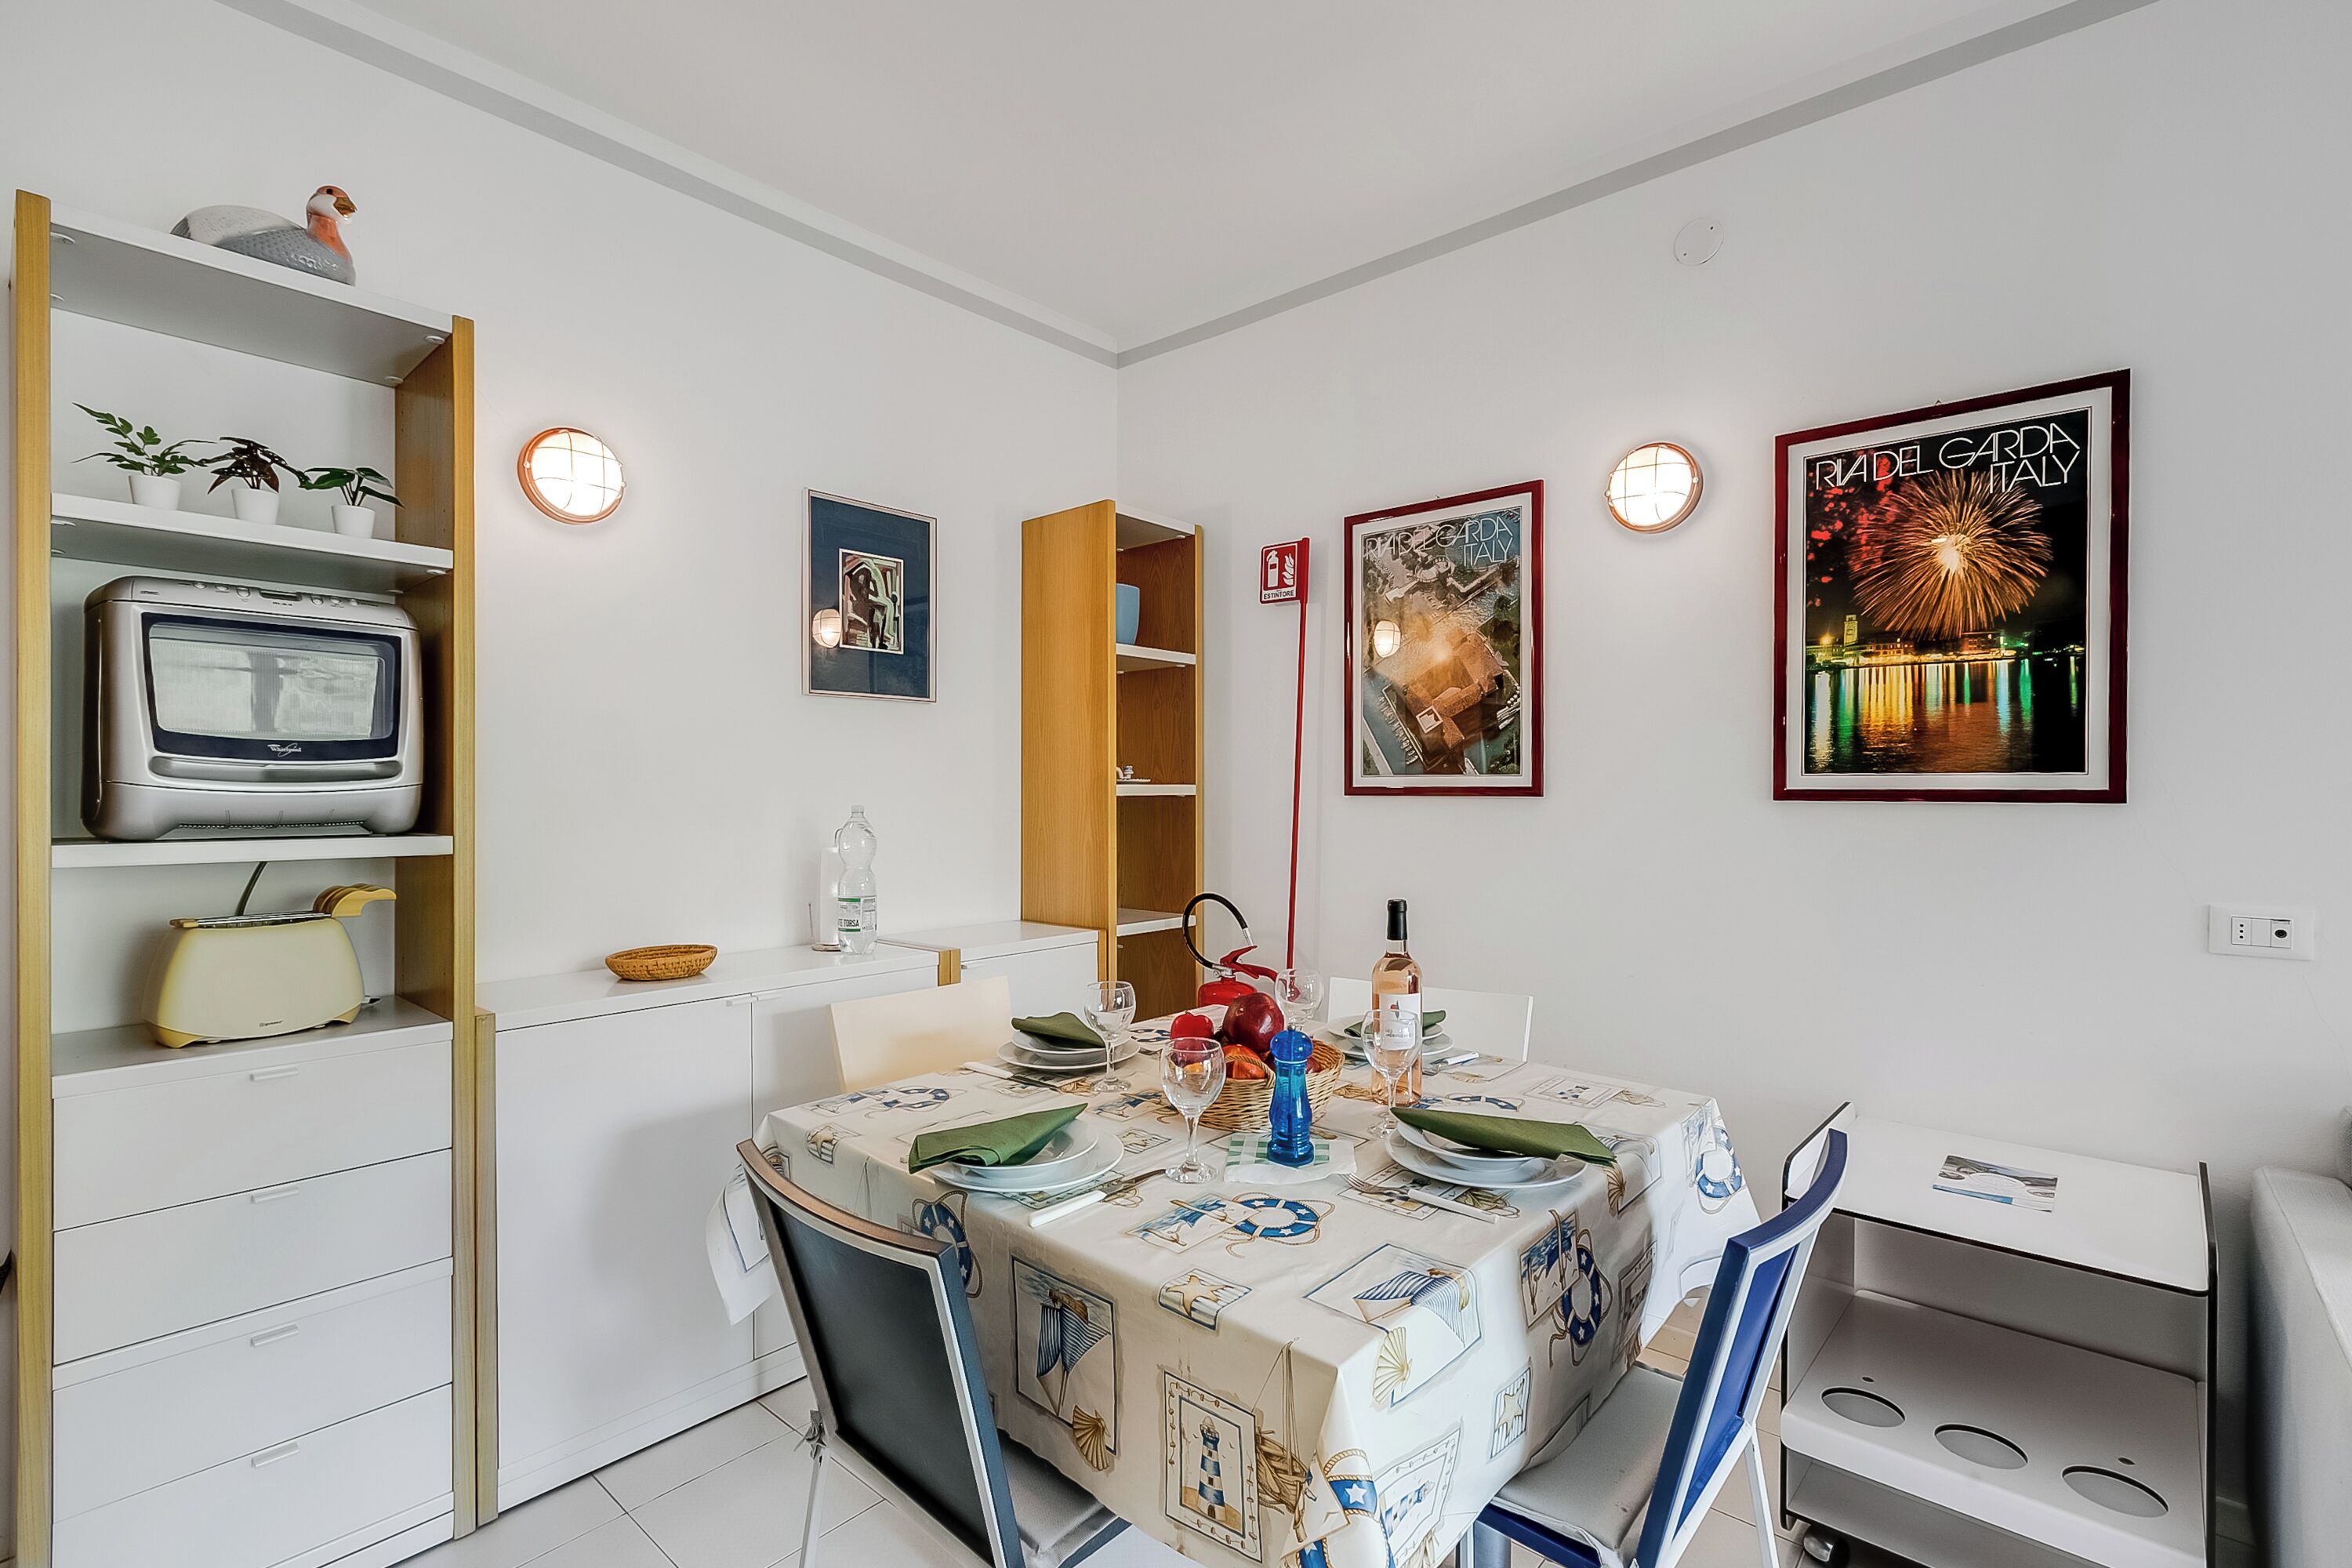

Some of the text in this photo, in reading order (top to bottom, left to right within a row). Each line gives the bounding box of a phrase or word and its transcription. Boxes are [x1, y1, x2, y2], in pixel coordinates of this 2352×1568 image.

[1816, 423, 2081, 490] RIVA DEL GARDA
[1990, 449, 2081, 494] ITALY
[1366, 516, 1514, 560] RIVA DEL GARDA
[1463, 537, 1513, 567] ITALY
[1263, 590, 1294, 600] ESTINTORE
[844, 919, 859, 927] TORSA
